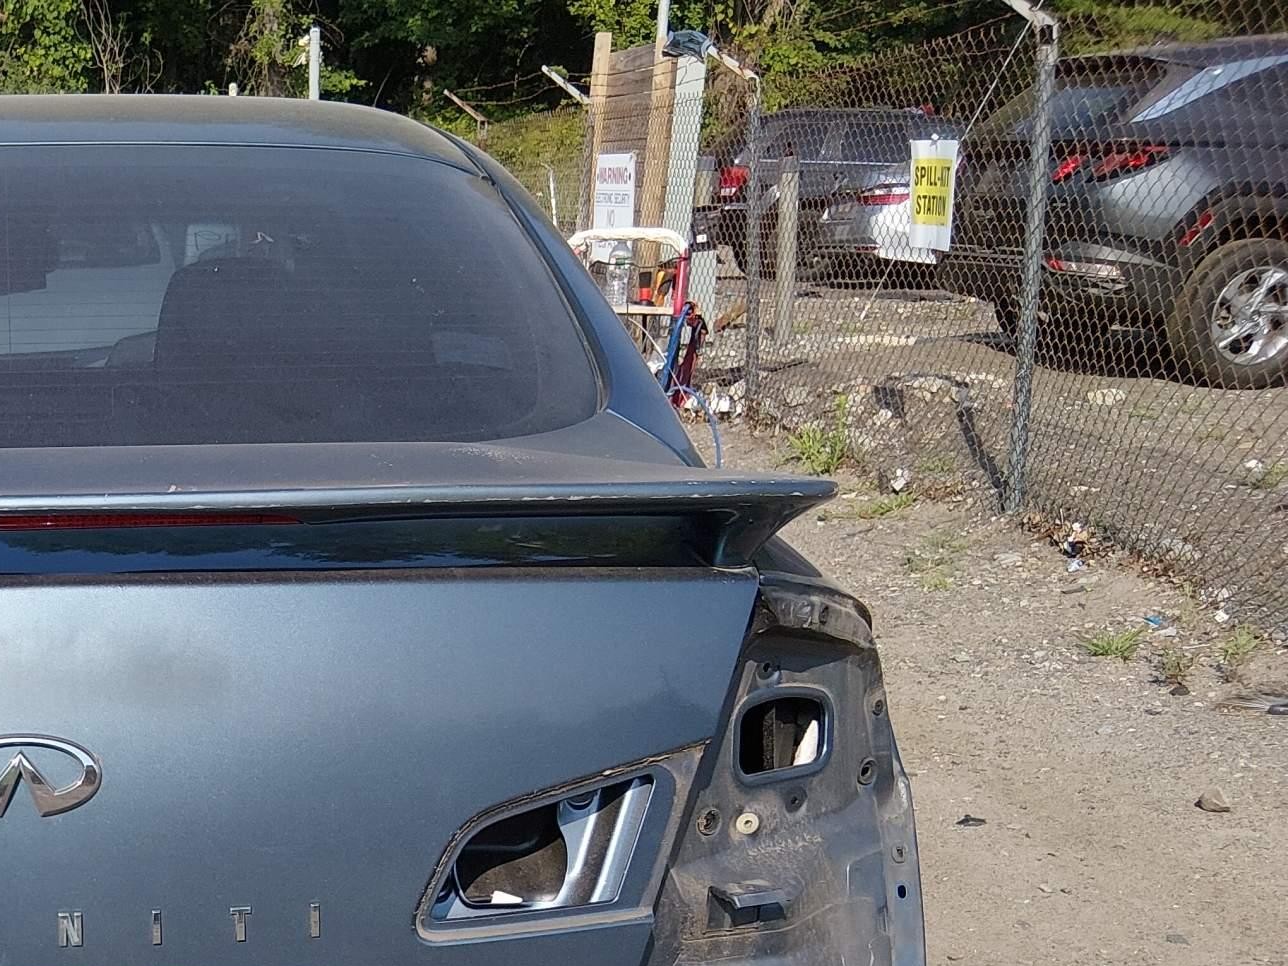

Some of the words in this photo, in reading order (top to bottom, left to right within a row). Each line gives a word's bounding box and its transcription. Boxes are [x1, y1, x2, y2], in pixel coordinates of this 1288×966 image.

[598, 166, 629, 185] WARNING
[914, 165, 951, 188] SPILL-KIT
[915, 194, 947, 217] STATION
